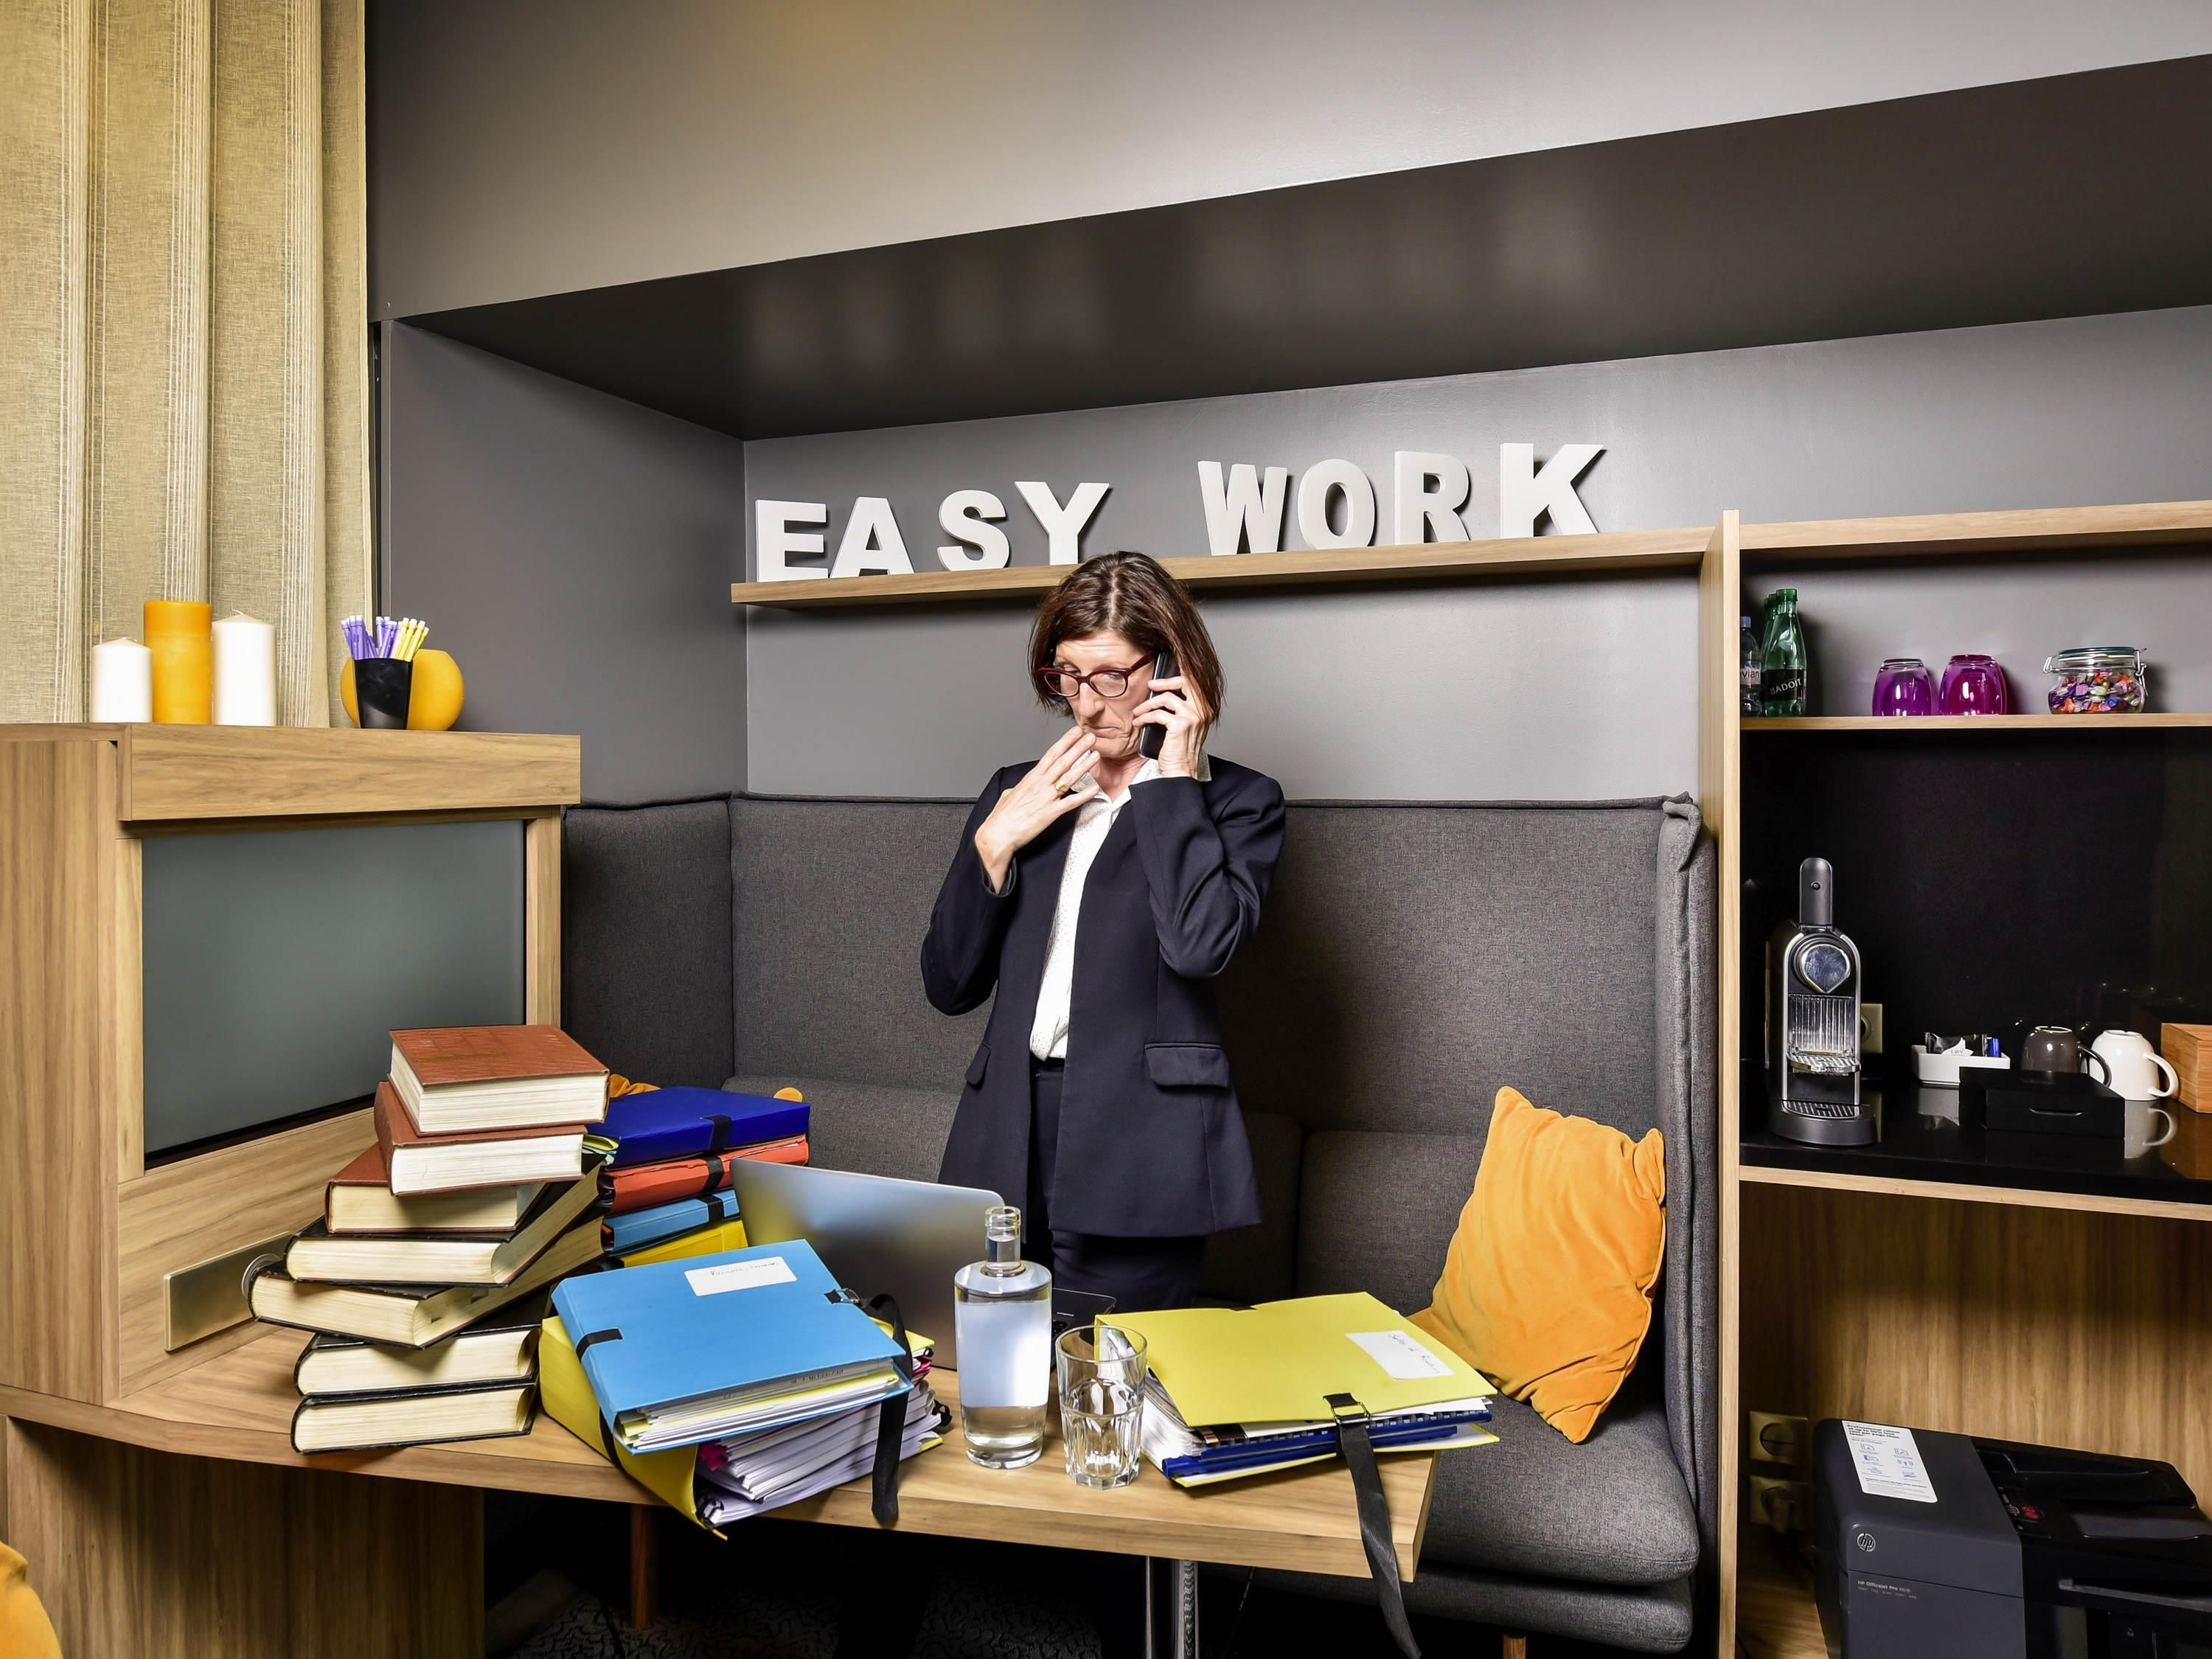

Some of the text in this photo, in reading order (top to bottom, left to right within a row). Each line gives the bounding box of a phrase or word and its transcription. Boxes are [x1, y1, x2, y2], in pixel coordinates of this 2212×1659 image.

[755, 442, 1604, 582] EASY WORK
[1741, 669, 1759, 679] vian
[1770, 678, 1801, 695] BADOIT
[1857, 1533, 1876, 1552] hp
